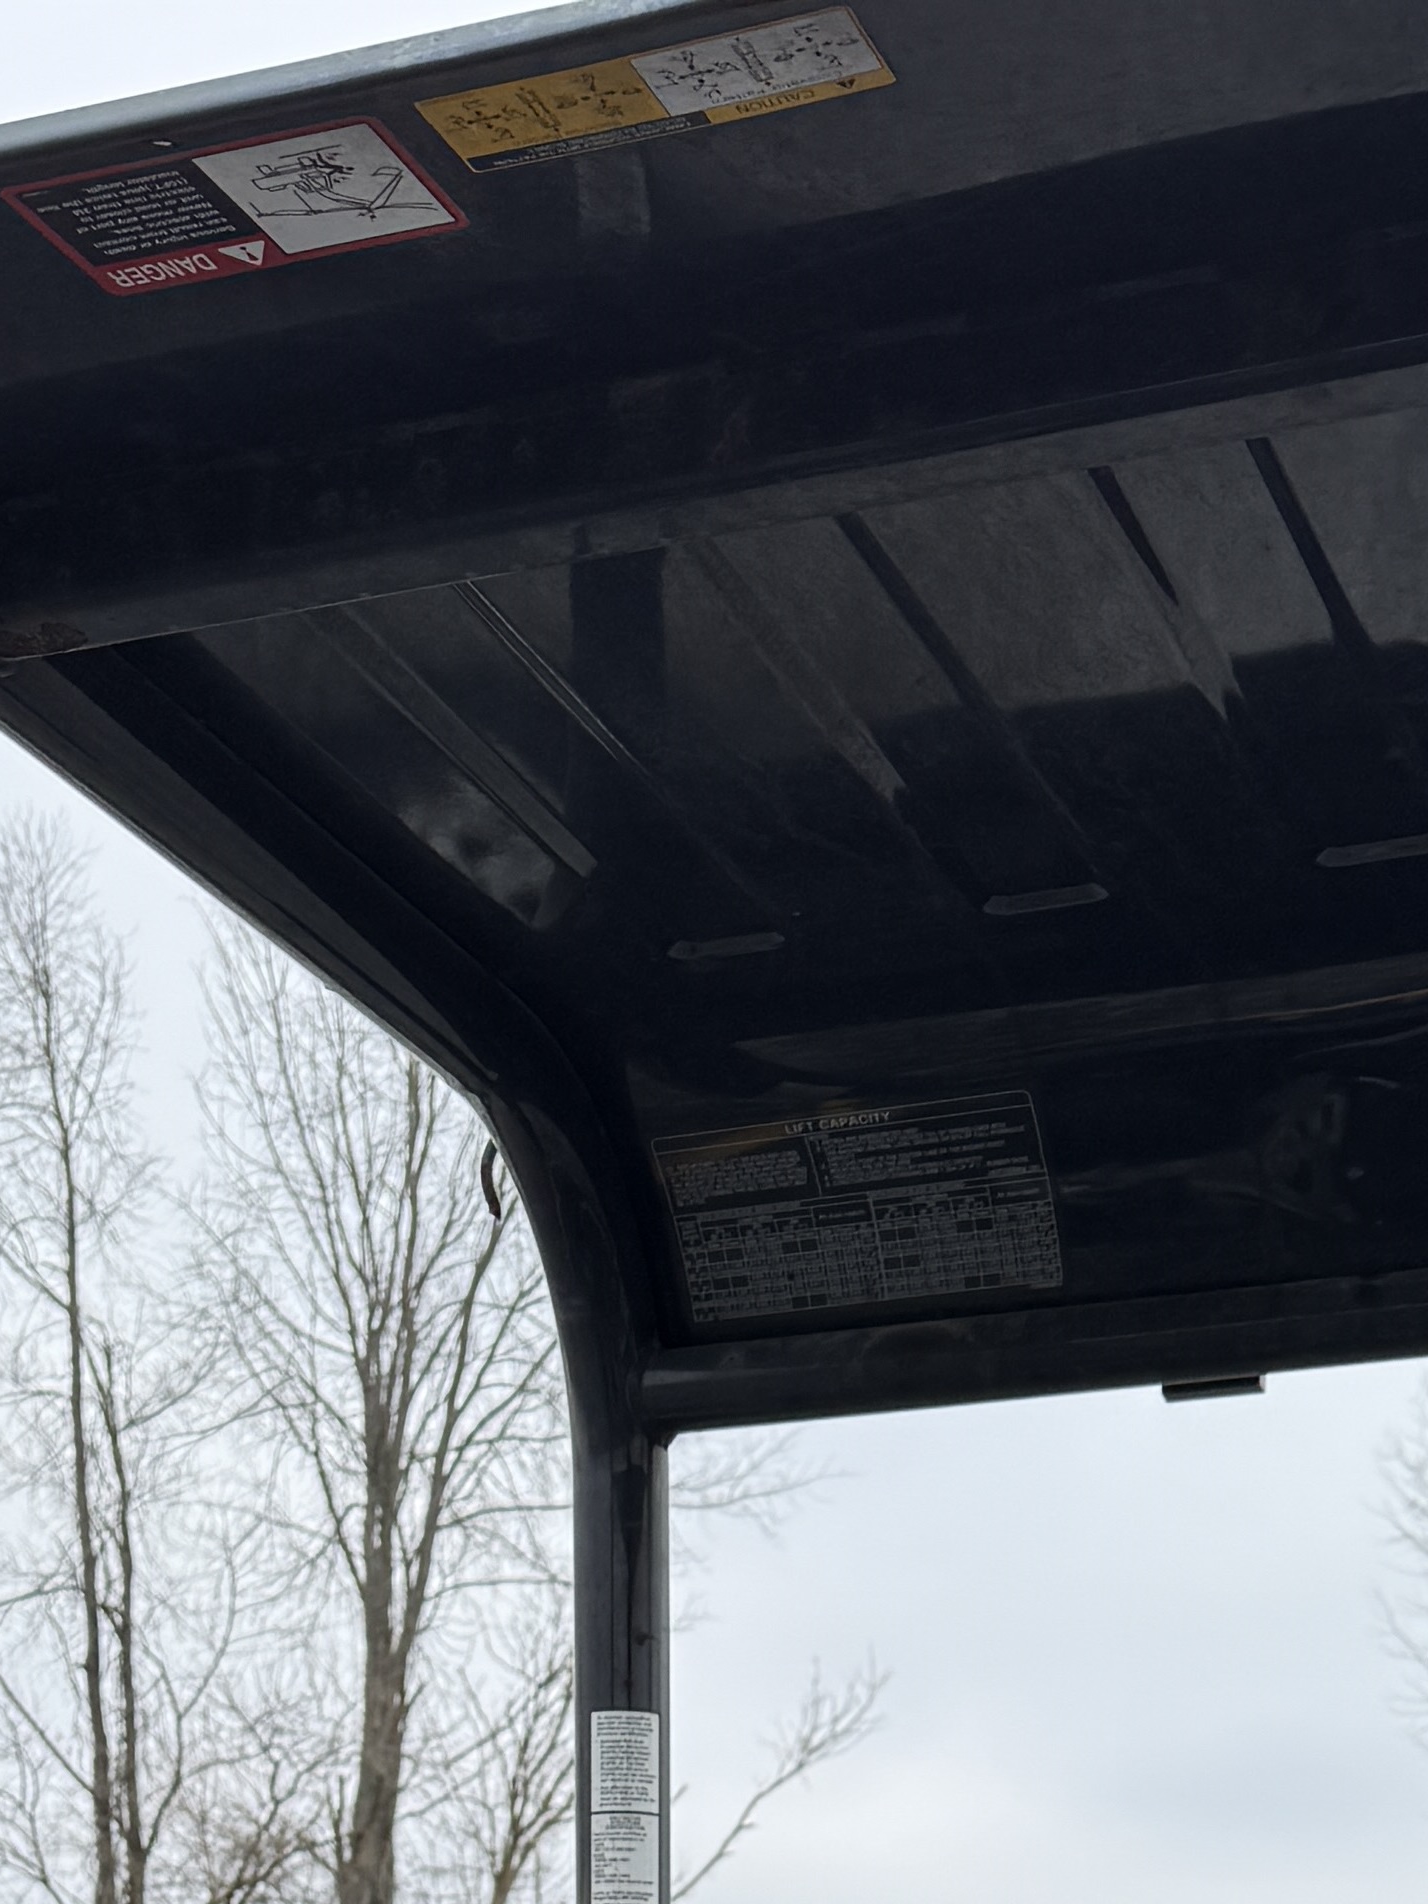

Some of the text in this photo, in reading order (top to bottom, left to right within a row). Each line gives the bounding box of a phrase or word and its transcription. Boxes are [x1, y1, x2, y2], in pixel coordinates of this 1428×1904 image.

[104, 252, 218, 288] DANGER
[784, 1111, 891, 1135] LIFT CAPACITY
